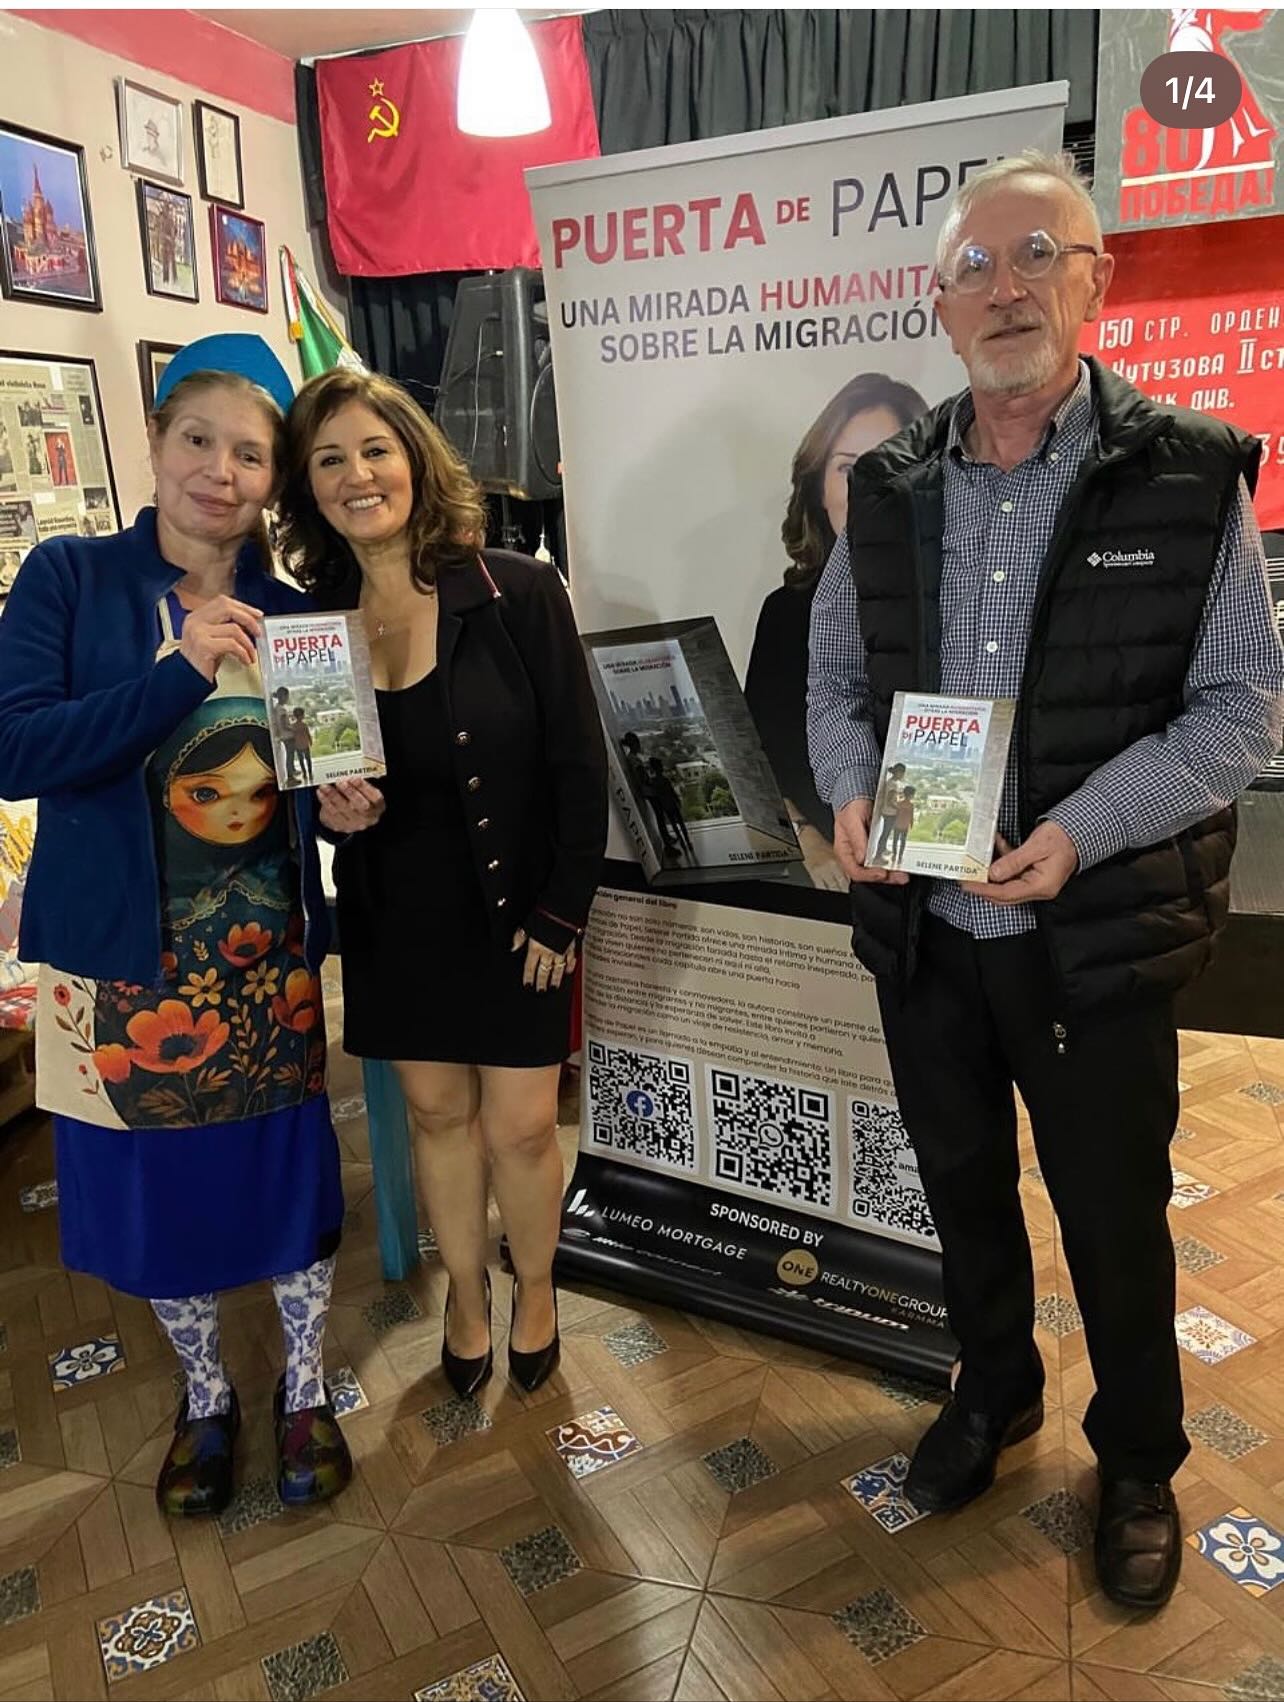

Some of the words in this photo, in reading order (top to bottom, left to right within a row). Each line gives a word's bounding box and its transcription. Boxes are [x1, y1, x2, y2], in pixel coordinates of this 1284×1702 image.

[1119, 169, 1275, 223] ПОБЕДА!
[553, 192, 765, 269] PUERTA
[776, 197, 811, 225] DE
[831, 155, 1005, 237] PAP
[561, 296, 620, 329] UNA
[629, 284, 749, 322] MIRADA
[1098, 318, 1133, 350] 150
[1145, 316, 1189, 341] СТР.
[1210, 306, 1284, 335] ОРДЕН
[600, 328, 698, 363] SOBRE
[707, 325, 745, 355] LA
[1102, 549, 1154, 561] Columbia
[274, 634, 343, 653] PUERTA
[286, 647, 336, 666] PAPEL
[906, 714, 981, 734] PUERTA
[913, 728, 968, 748] PAPEL
[916, 860, 941, 870] SELENE
[943, 864, 977, 874] PARTIDA
[601, 1206, 653, 1232] LUMEO
[657, 1224, 747, 1260] MORTGAGE
[709, 1202, 800, 1241] SPONSORED
[803, 1230, 824, 1248] BY
[781, 1259, 815, 1279] ONE
